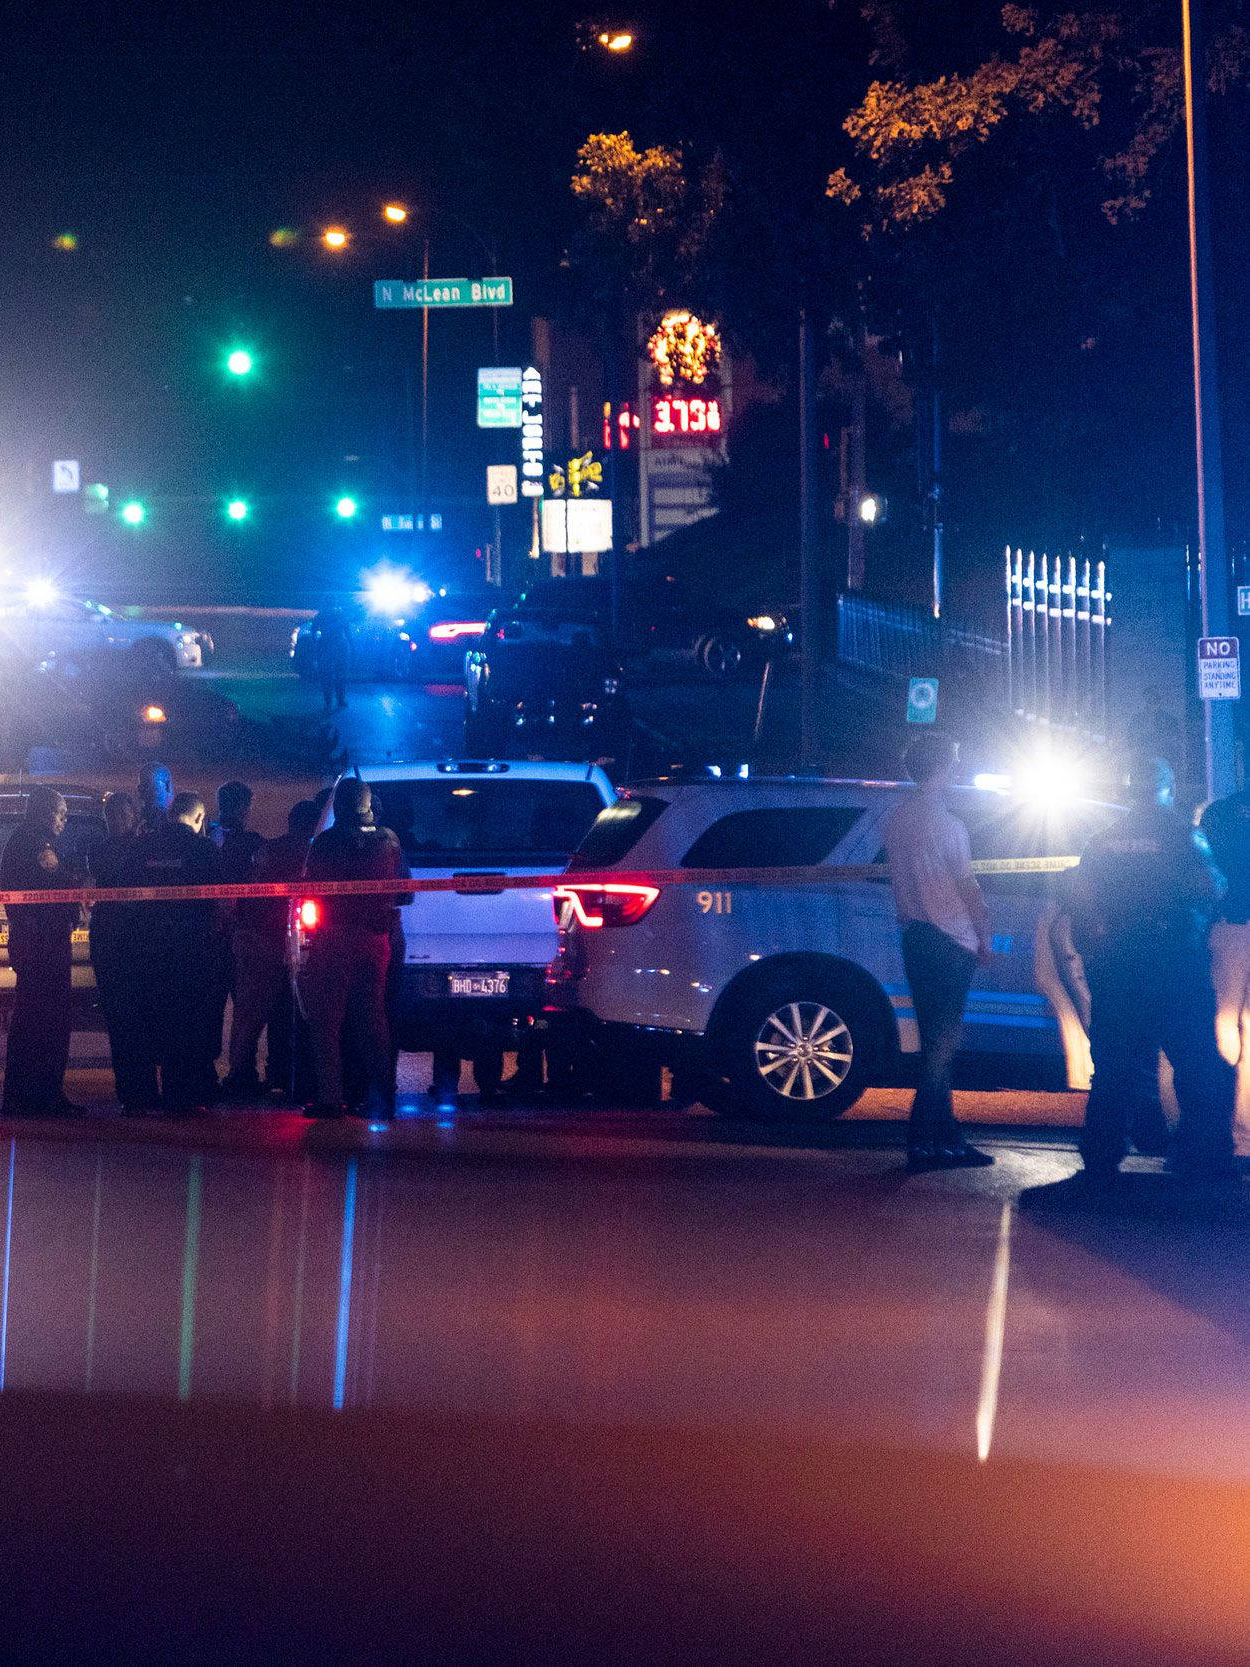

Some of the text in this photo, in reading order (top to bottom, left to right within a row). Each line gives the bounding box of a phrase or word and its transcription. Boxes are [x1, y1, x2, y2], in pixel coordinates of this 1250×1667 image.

[383, 283, 505, 302] N McLean Blvd
[492, 485, 514, 497] 40
[1206, 641, 1230, 656] NO
[1204, 661, 1235, 669] PARKING
[1204, 672, 1236, 680] STANDING
[1204, 681, 1236, 689] ANYTIME
[697, 891, 732, 914] 911
[481, 979, 506, 993] 4376
